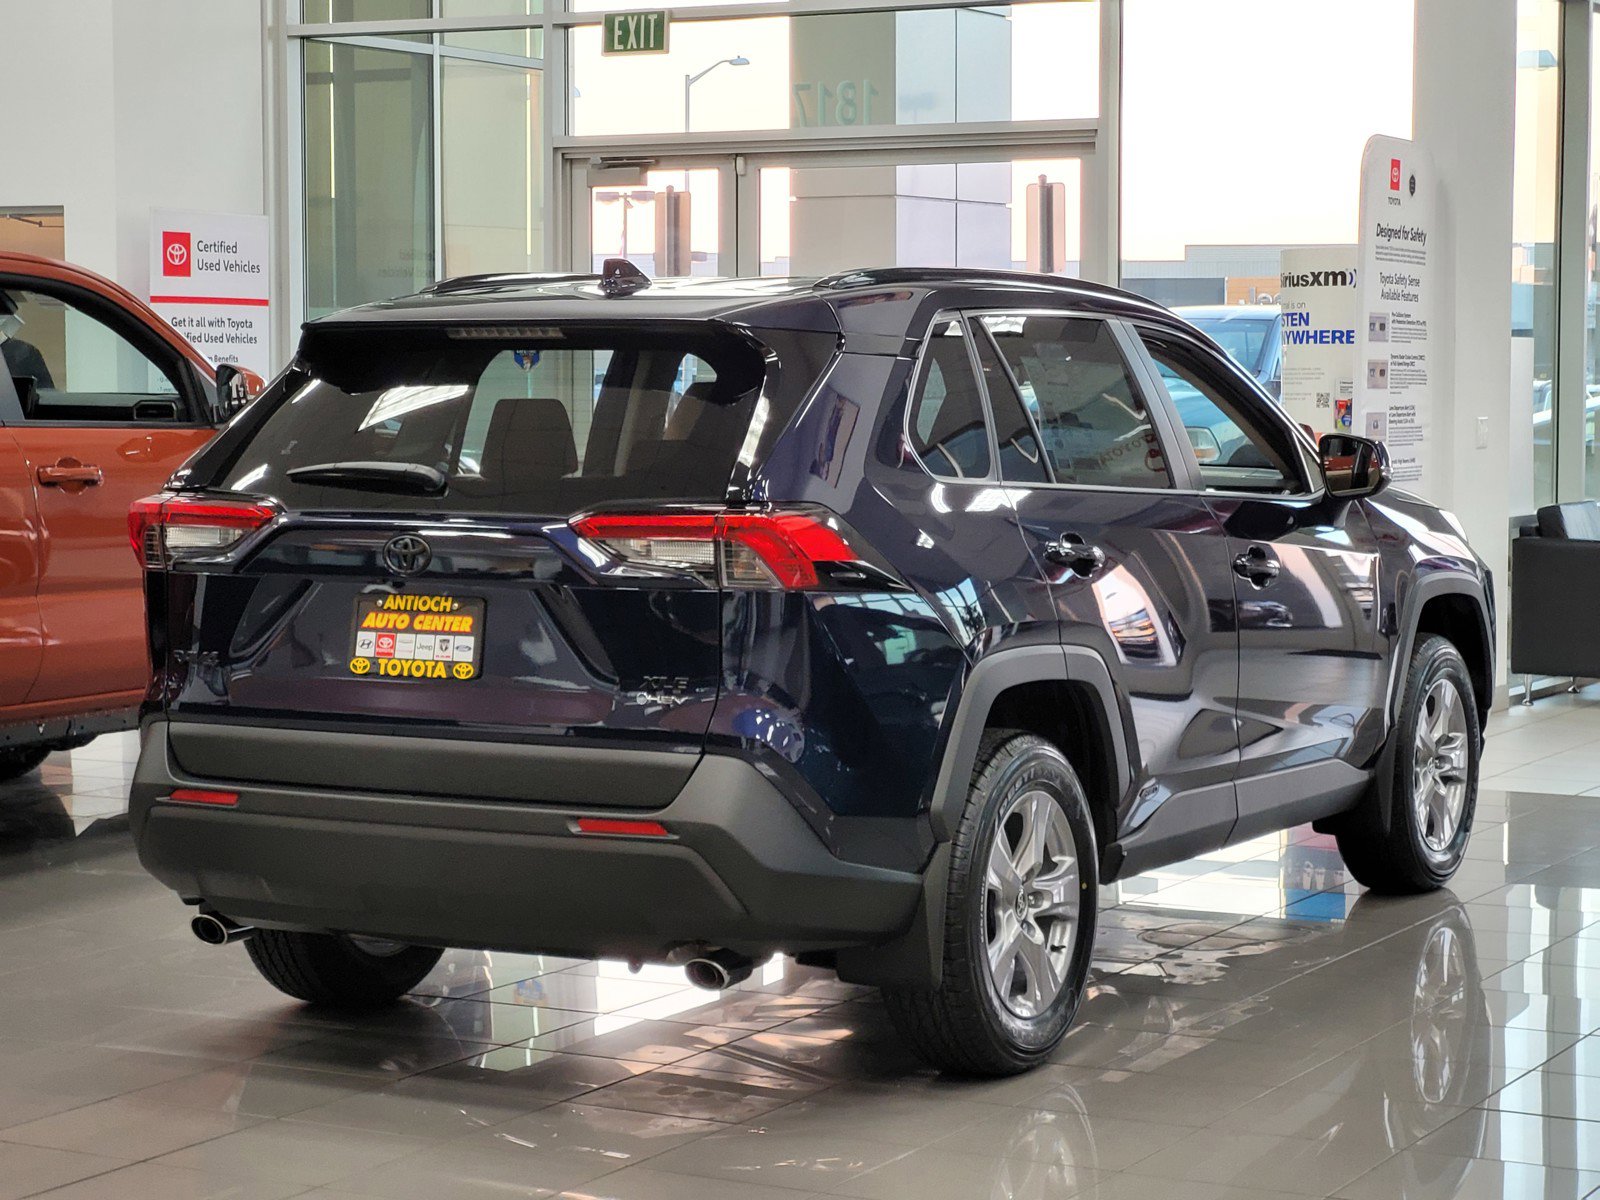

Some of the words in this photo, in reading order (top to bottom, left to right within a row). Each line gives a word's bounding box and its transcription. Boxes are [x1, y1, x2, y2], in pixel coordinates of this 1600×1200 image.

[613, 14, 658, 50] EXIT
[1388, 197, 1401, 206] TOYOTA
[1376, 223, 1402, 242] Designed
[1402, 225, 1410, 240] for
[1410, 227, 1427, 246] Safety
[197, 240, 238, 254] Certified
[197, 259, 221, 272] Used
[223, 260, 261, 274] Vehicles
[1379, 272, 1394, 287] Toyota
[1395, 273, 1408, 289] Safety
[1408, 274, 1420, 288] Sense
[1380, 289, 1401, 301] Available
[1401, 290, 1419, 302] Features
[171, 317, 186, 327] Get
[188, 317, 194, 327] it
[196, 317, 206, 327] all
[208, 317, 225, 328] with
[227, 318, 253, 331] Toyota
[204, 333, 224, 343] Used
[225, 333, 258, 344] Vehicles
[214, 355, 239, 363] Benefits
[383, 595, 453, 612] ANTIOCH
[361, 612, 410, 630] AUTO
[413, 614, 473, 632] CENTER
[377, 659, 447, 679] TOYOTA
